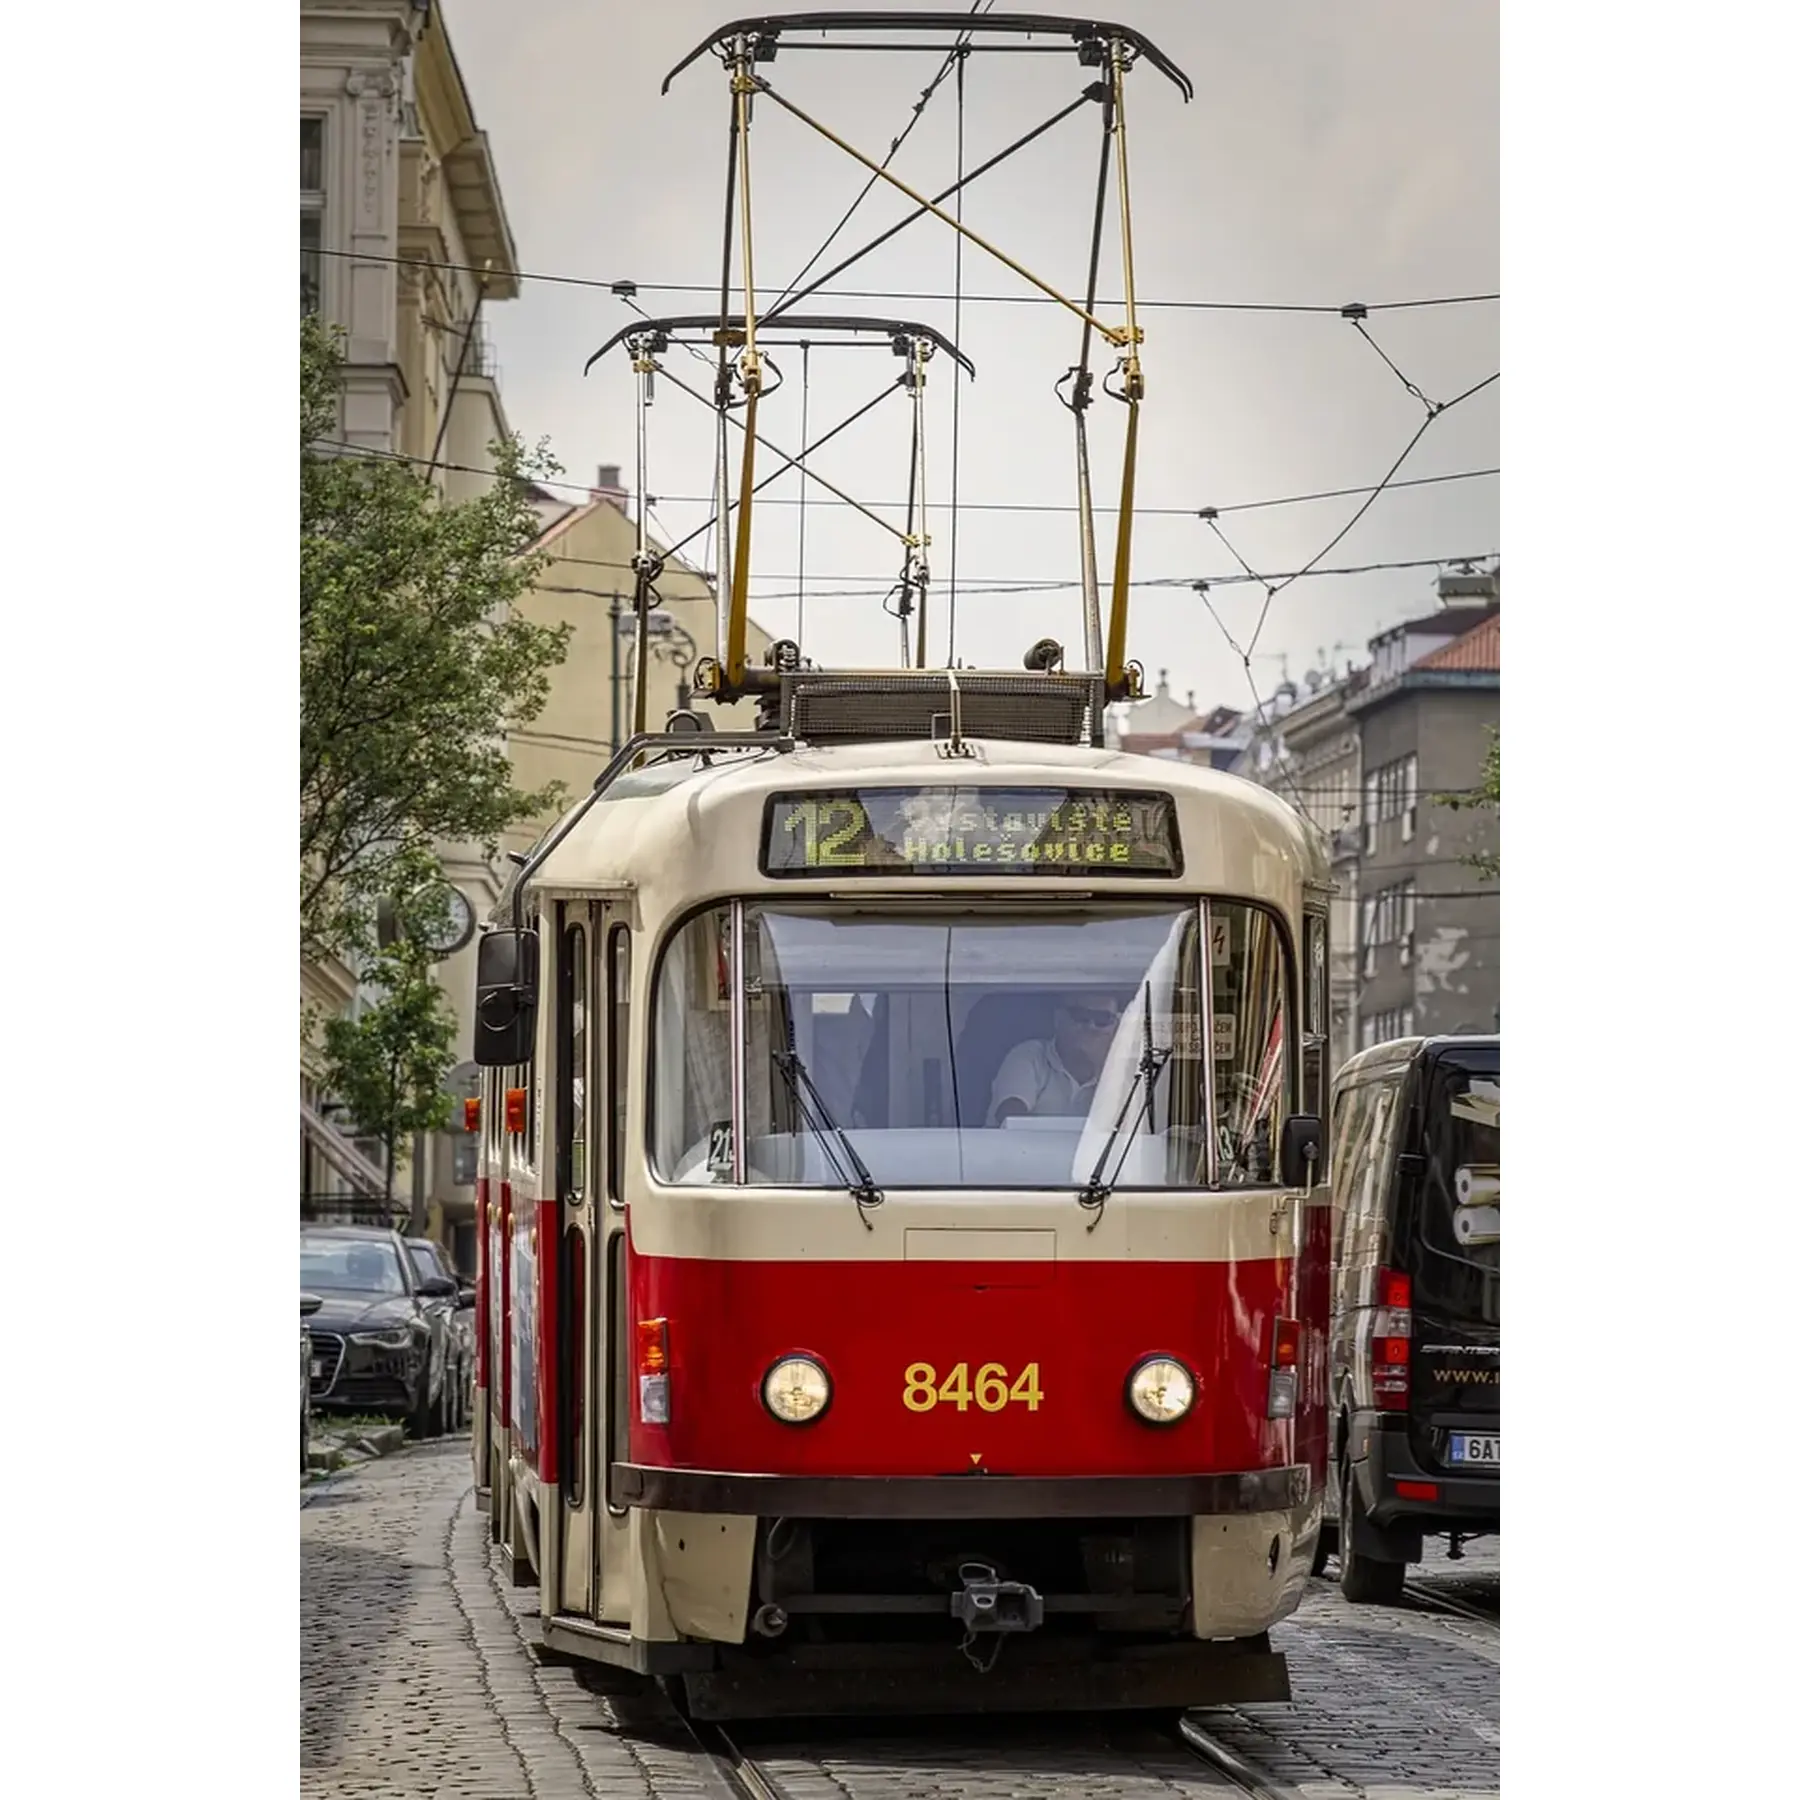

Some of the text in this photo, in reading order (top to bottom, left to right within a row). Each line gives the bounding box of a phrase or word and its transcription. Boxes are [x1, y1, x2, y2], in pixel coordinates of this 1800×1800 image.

[784, 800, 864, 866] 12
[904, 833, 1130, 863] Holešovice
[902, 1362, 1045, 1412] 8464
